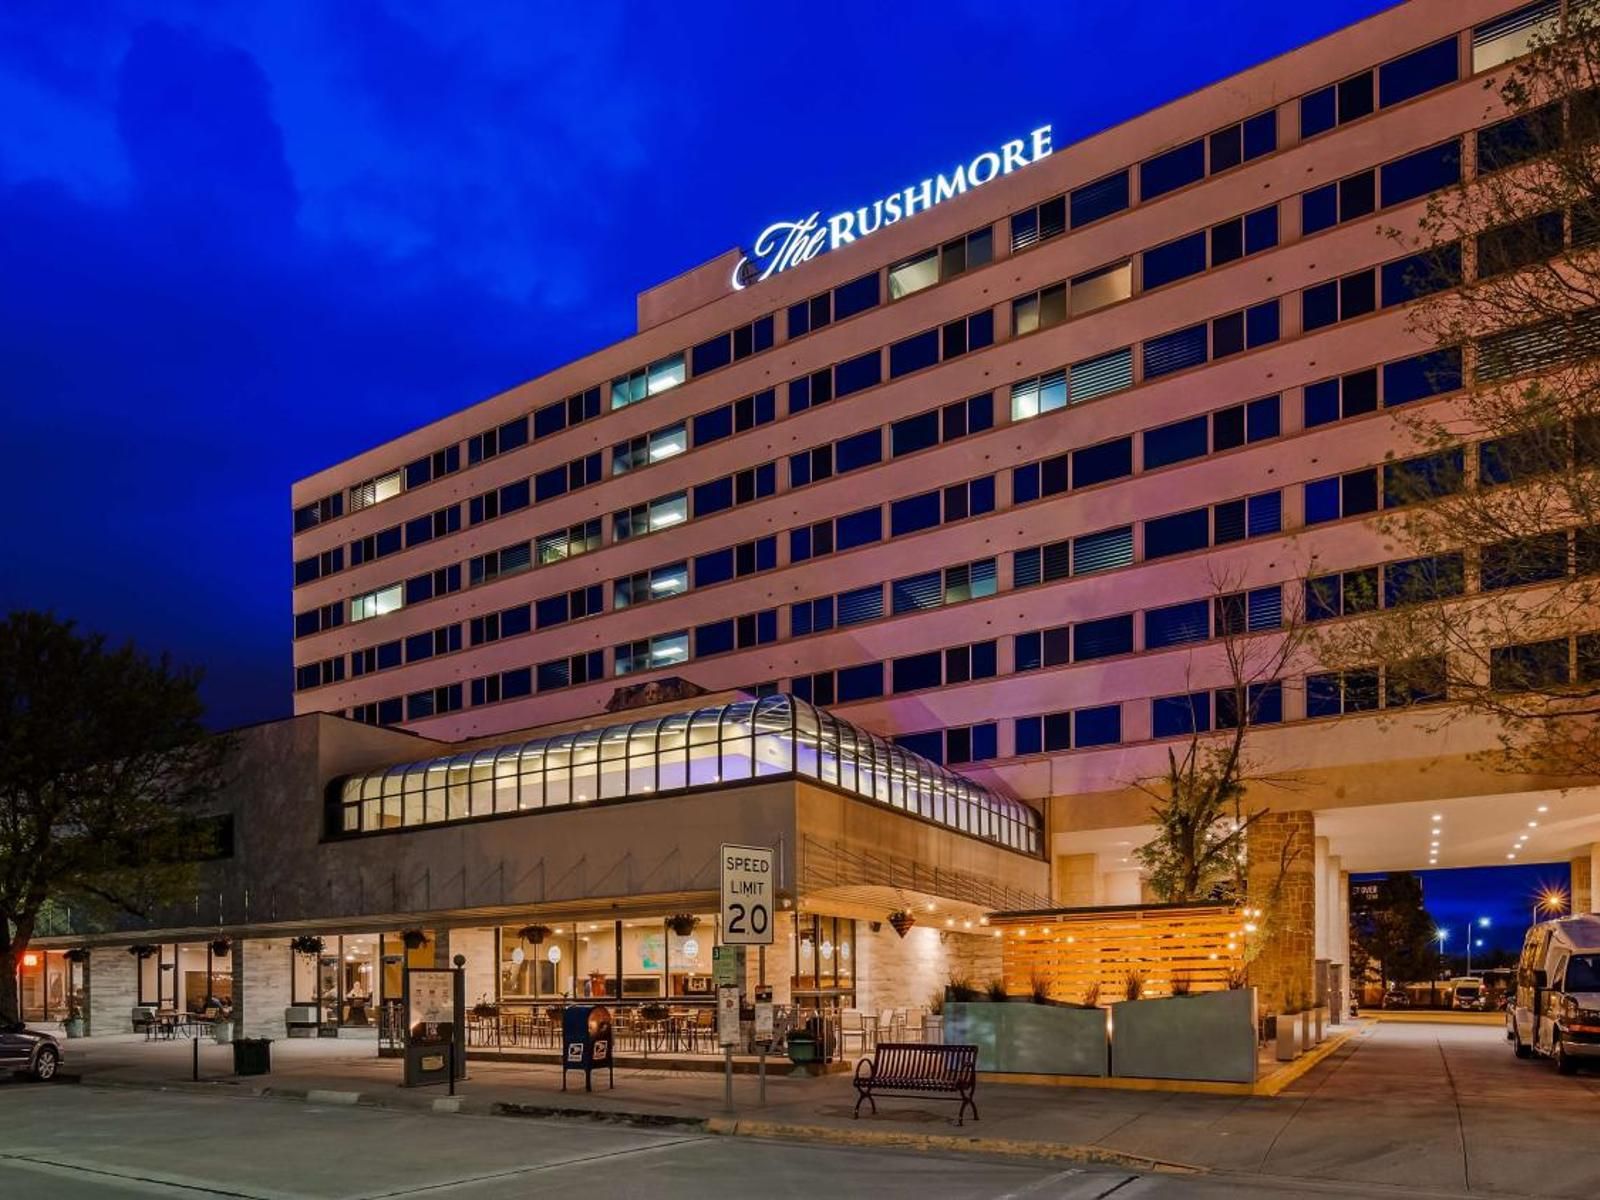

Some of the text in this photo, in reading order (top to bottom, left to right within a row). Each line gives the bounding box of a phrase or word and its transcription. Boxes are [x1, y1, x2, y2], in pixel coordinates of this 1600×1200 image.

[731, 125, 1053, 290] The RUSHMORE
[726, 856, 770, 873] SPEED
[730, 881, 765, 896] LIMIT
[728, 903, 768, 935] 20
